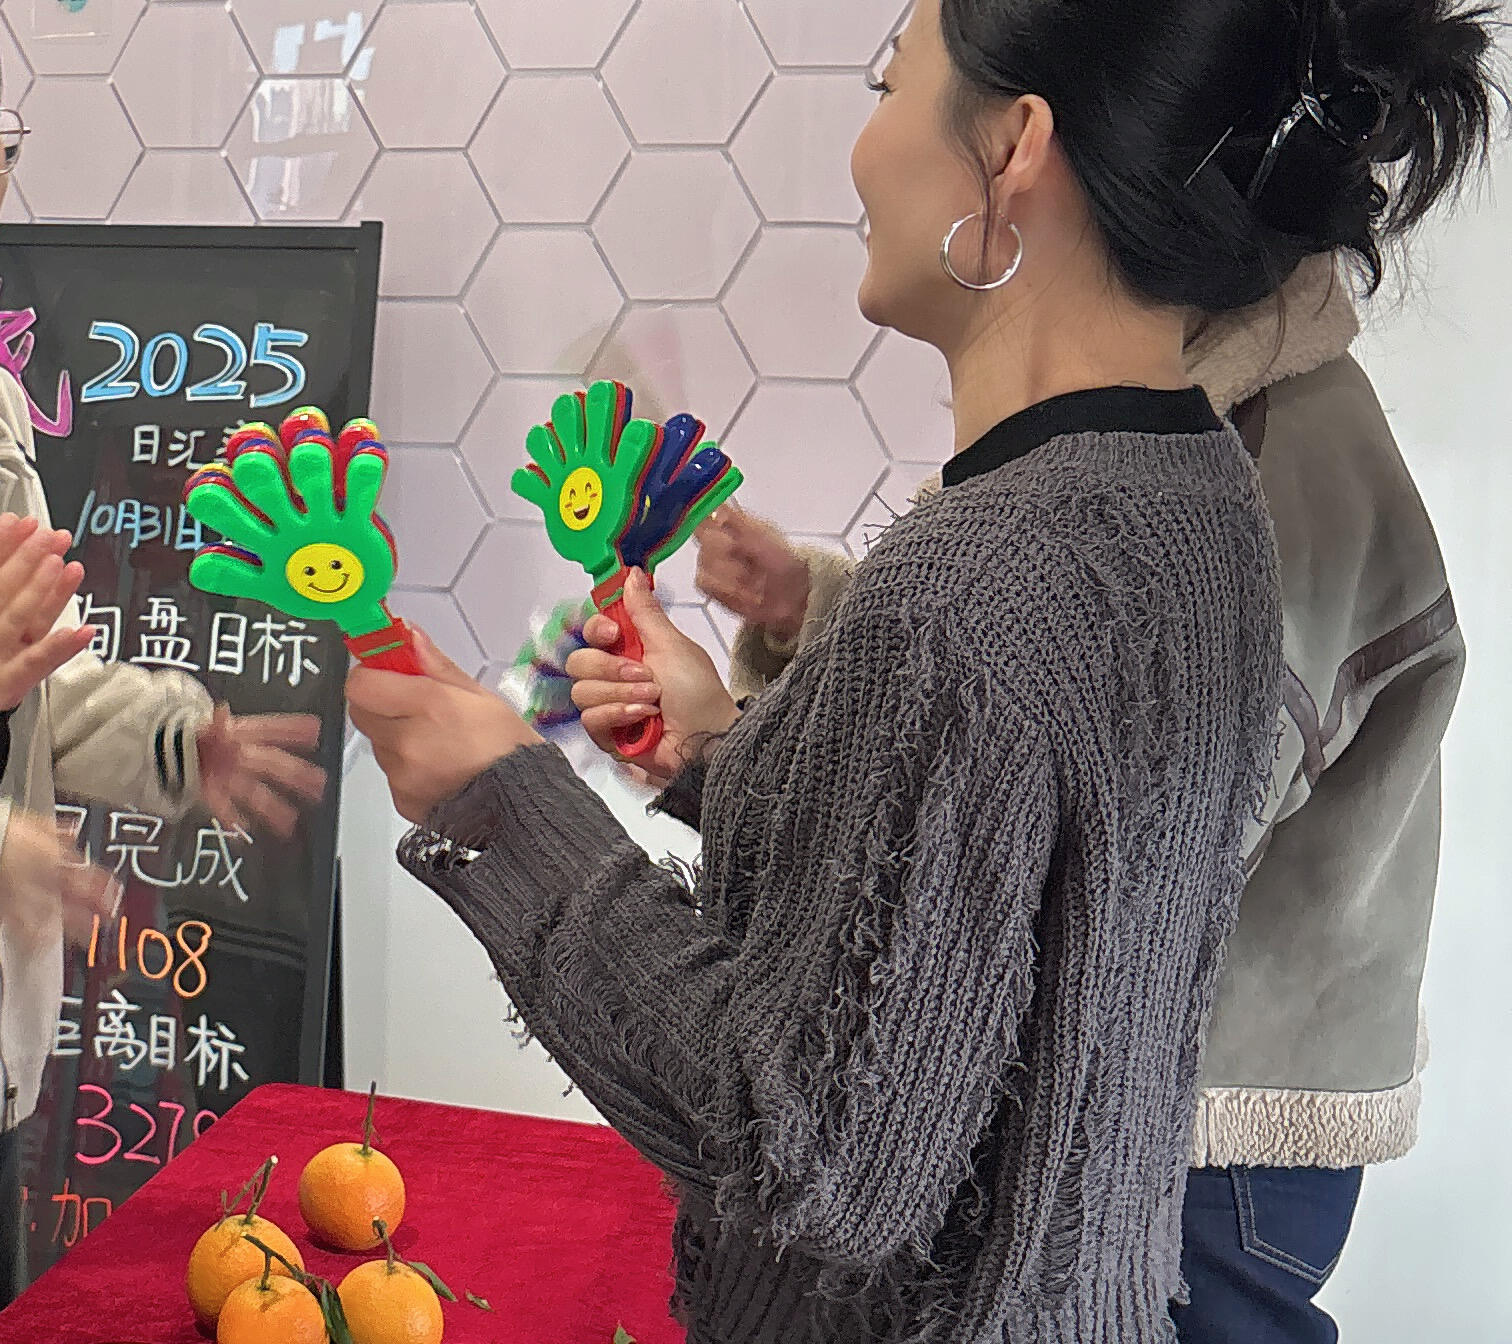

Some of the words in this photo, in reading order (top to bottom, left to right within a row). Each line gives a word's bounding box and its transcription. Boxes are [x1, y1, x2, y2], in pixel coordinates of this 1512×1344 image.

[80, 320, 309, 409] 2025
[131, 420, 245, 471] 日汇
[87, 912, 213, 998] 1108
